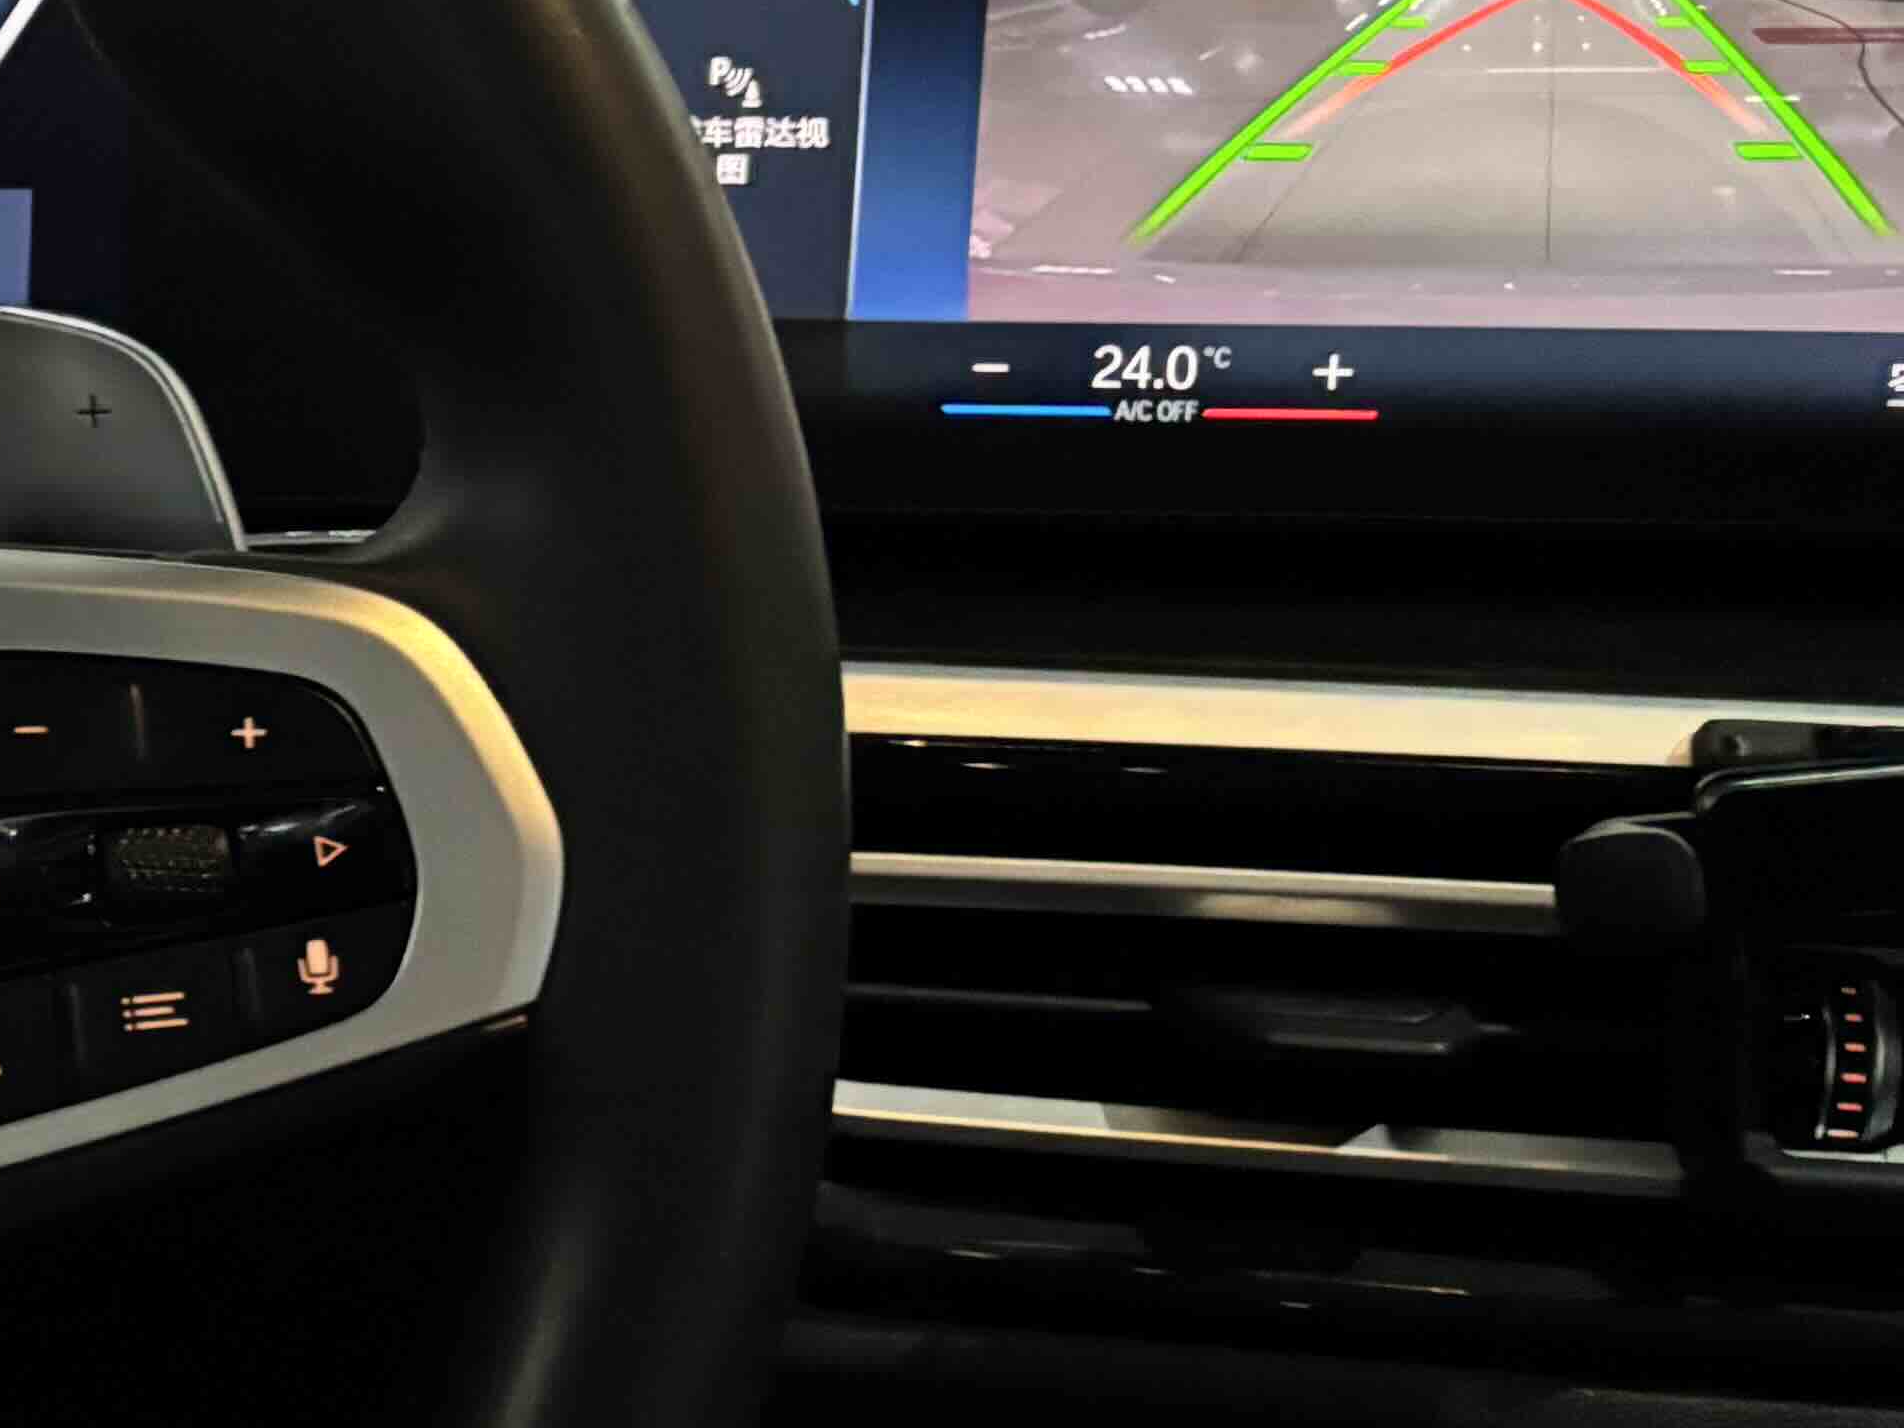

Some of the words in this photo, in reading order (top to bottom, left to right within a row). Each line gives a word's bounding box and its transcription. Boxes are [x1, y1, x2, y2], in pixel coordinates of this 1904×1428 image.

[691, 115, 830, 149] 车雷达视
[1091, 344, 1198, 391] 24.0
[1156, 399, 1199, 423] OFF
